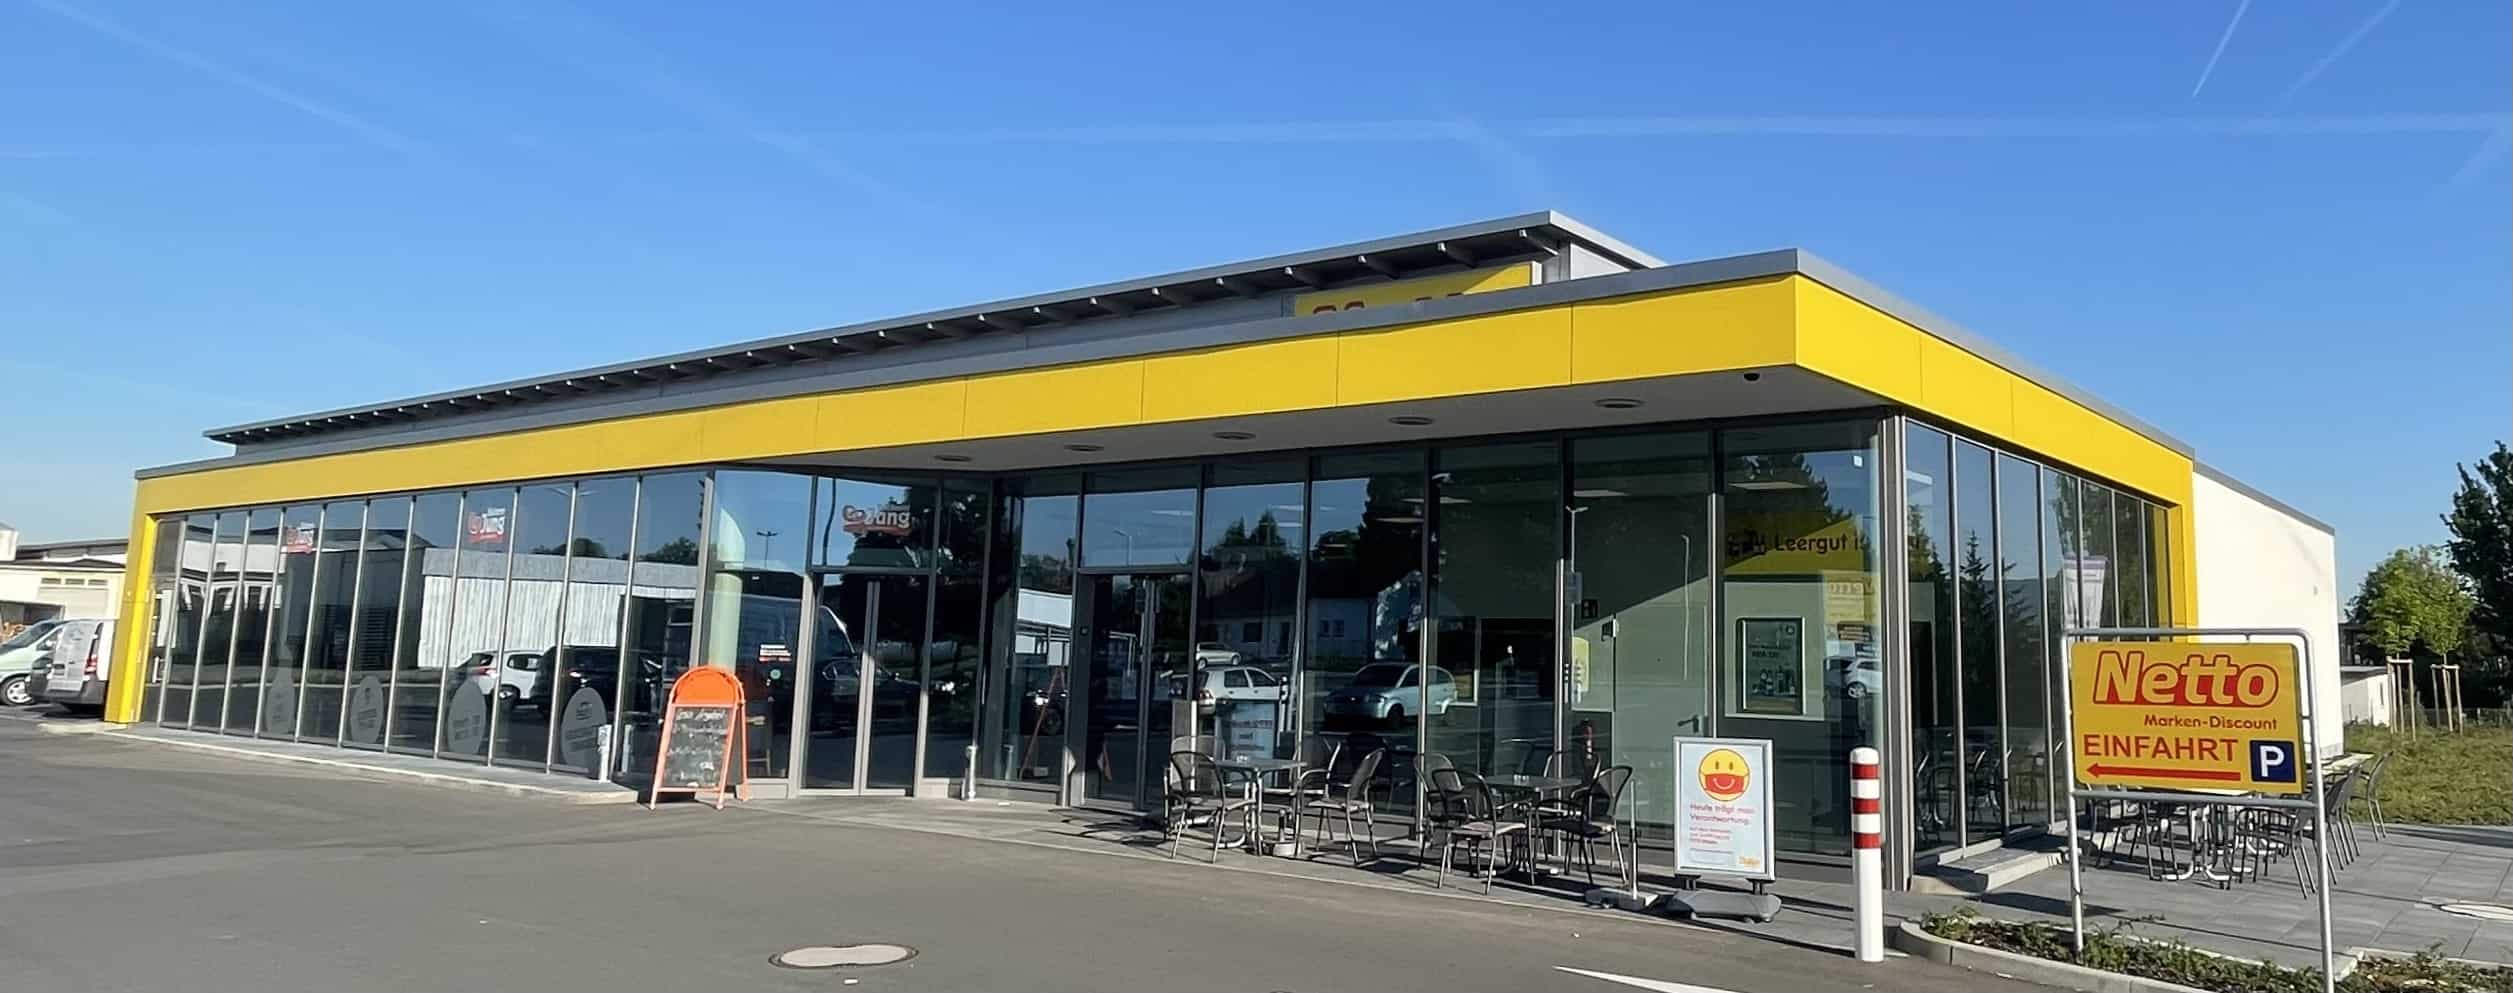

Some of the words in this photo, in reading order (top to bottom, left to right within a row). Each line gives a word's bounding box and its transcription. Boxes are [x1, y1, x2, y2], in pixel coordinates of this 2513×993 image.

[1775, 533, 1848, 555] Leergut
[2093, 650, 2279, 708] Netto
[2143, 714, 2277, 731] Marken-Discount
[2083, 734, 2239, 762] EINFAHRT
[2259, 745, 2285, 777] P
